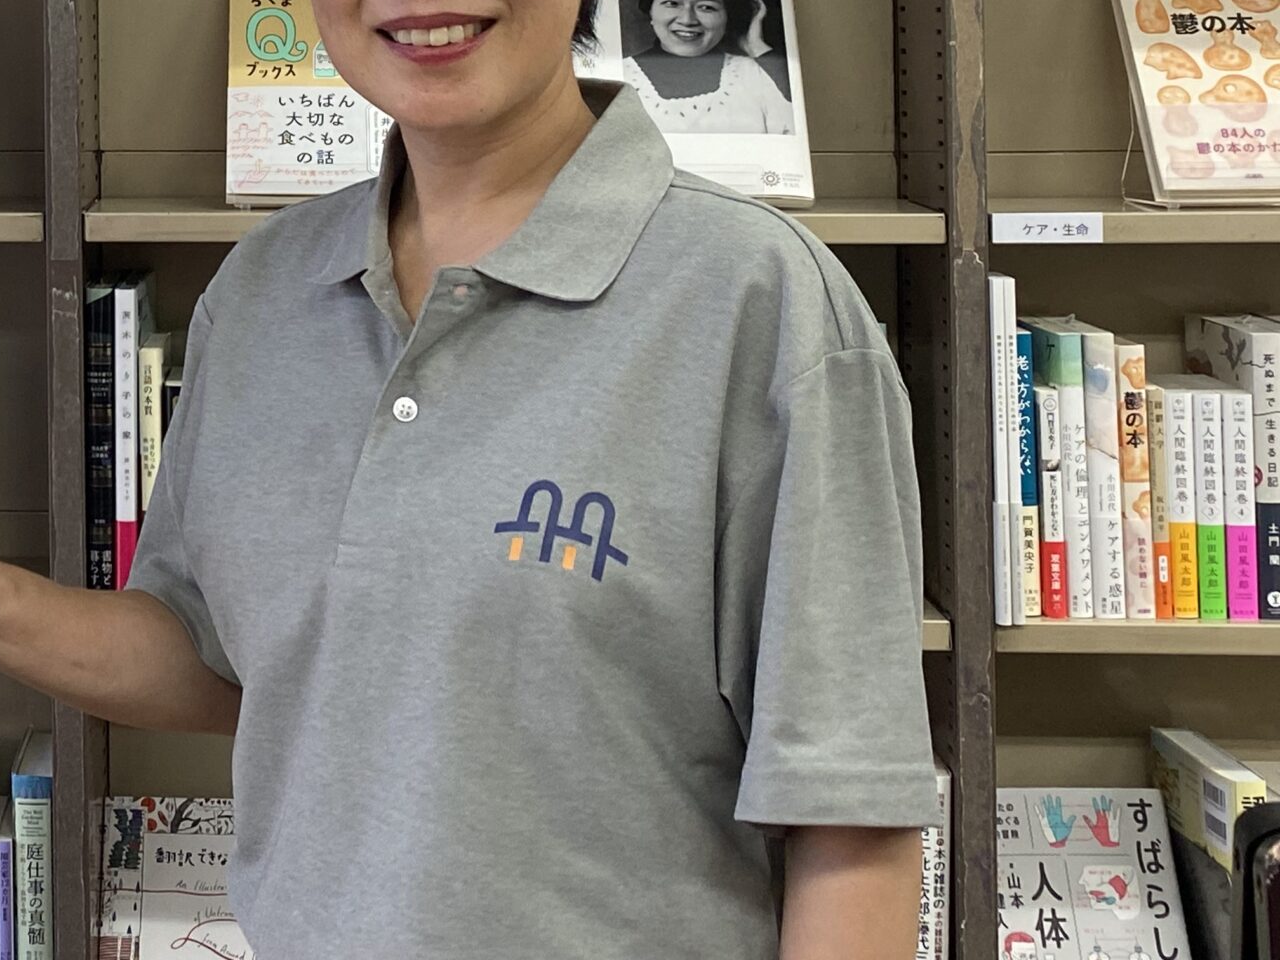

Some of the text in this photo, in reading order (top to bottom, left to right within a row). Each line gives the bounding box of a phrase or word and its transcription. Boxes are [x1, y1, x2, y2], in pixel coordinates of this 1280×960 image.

[245, 6, 309, 63] Q
[1170, 12, 1257, 35] 鬱の本
[246, 61, 297, 80] ブックス
[278, 92, 356, 109] いちばん
[286, 111, 345, 127] 大切な
[277, 129, 355, 147] 食べもの
[296, 149, 336, 166] の話
[1220, 127, 1267, 140] 84人の
[1022, 223, 1090, 237] ケア・生命
[143, 364, 153, 416] 言語の本質
[1016, 355, 1033, 477] 老い方がわからない
[1062, 423, 1072, 462] 小川公代
[1124, 391, 1145, 449] 鬱の本
[1263, 353, 1279, 488] 死ぬまで生きる日記
[1173, 424, 1188, 502] 人間臨終図巻
[1202, 426, 1217, 504] 人間臨終図巻
[1233, 426, 1249, 505] 人間臨終図巻
[1074, 423, 1093, 615] ケアの倫理とエンパワメント
[1106, 472, 1117, 513] 小川公代
[89, 550, 100, 586] 暮らす
[101, 549, 113, 586] 書物と
[1022, 514, 1035, 575] 門賀美央子
[1051, 553, 1061, 590] 双葉文庫
[1107, 518, 1124, 615] ケアする惑星
[1179, 528, 1192, 587] 山田風太郎
[1206, 530, 1218, 588] 山田風太郎
[1237, 531, 1250, 589] 山田風太郎
[154, 847, 228, 867] 翻訳できな
[997, 829, 1019, 839] 冒険
[26, 842, 46, 946] 庭仕事の真髄
[1031, 861, 1071, 949] 人体
[1126, 798, 1179, 960] すばらし
